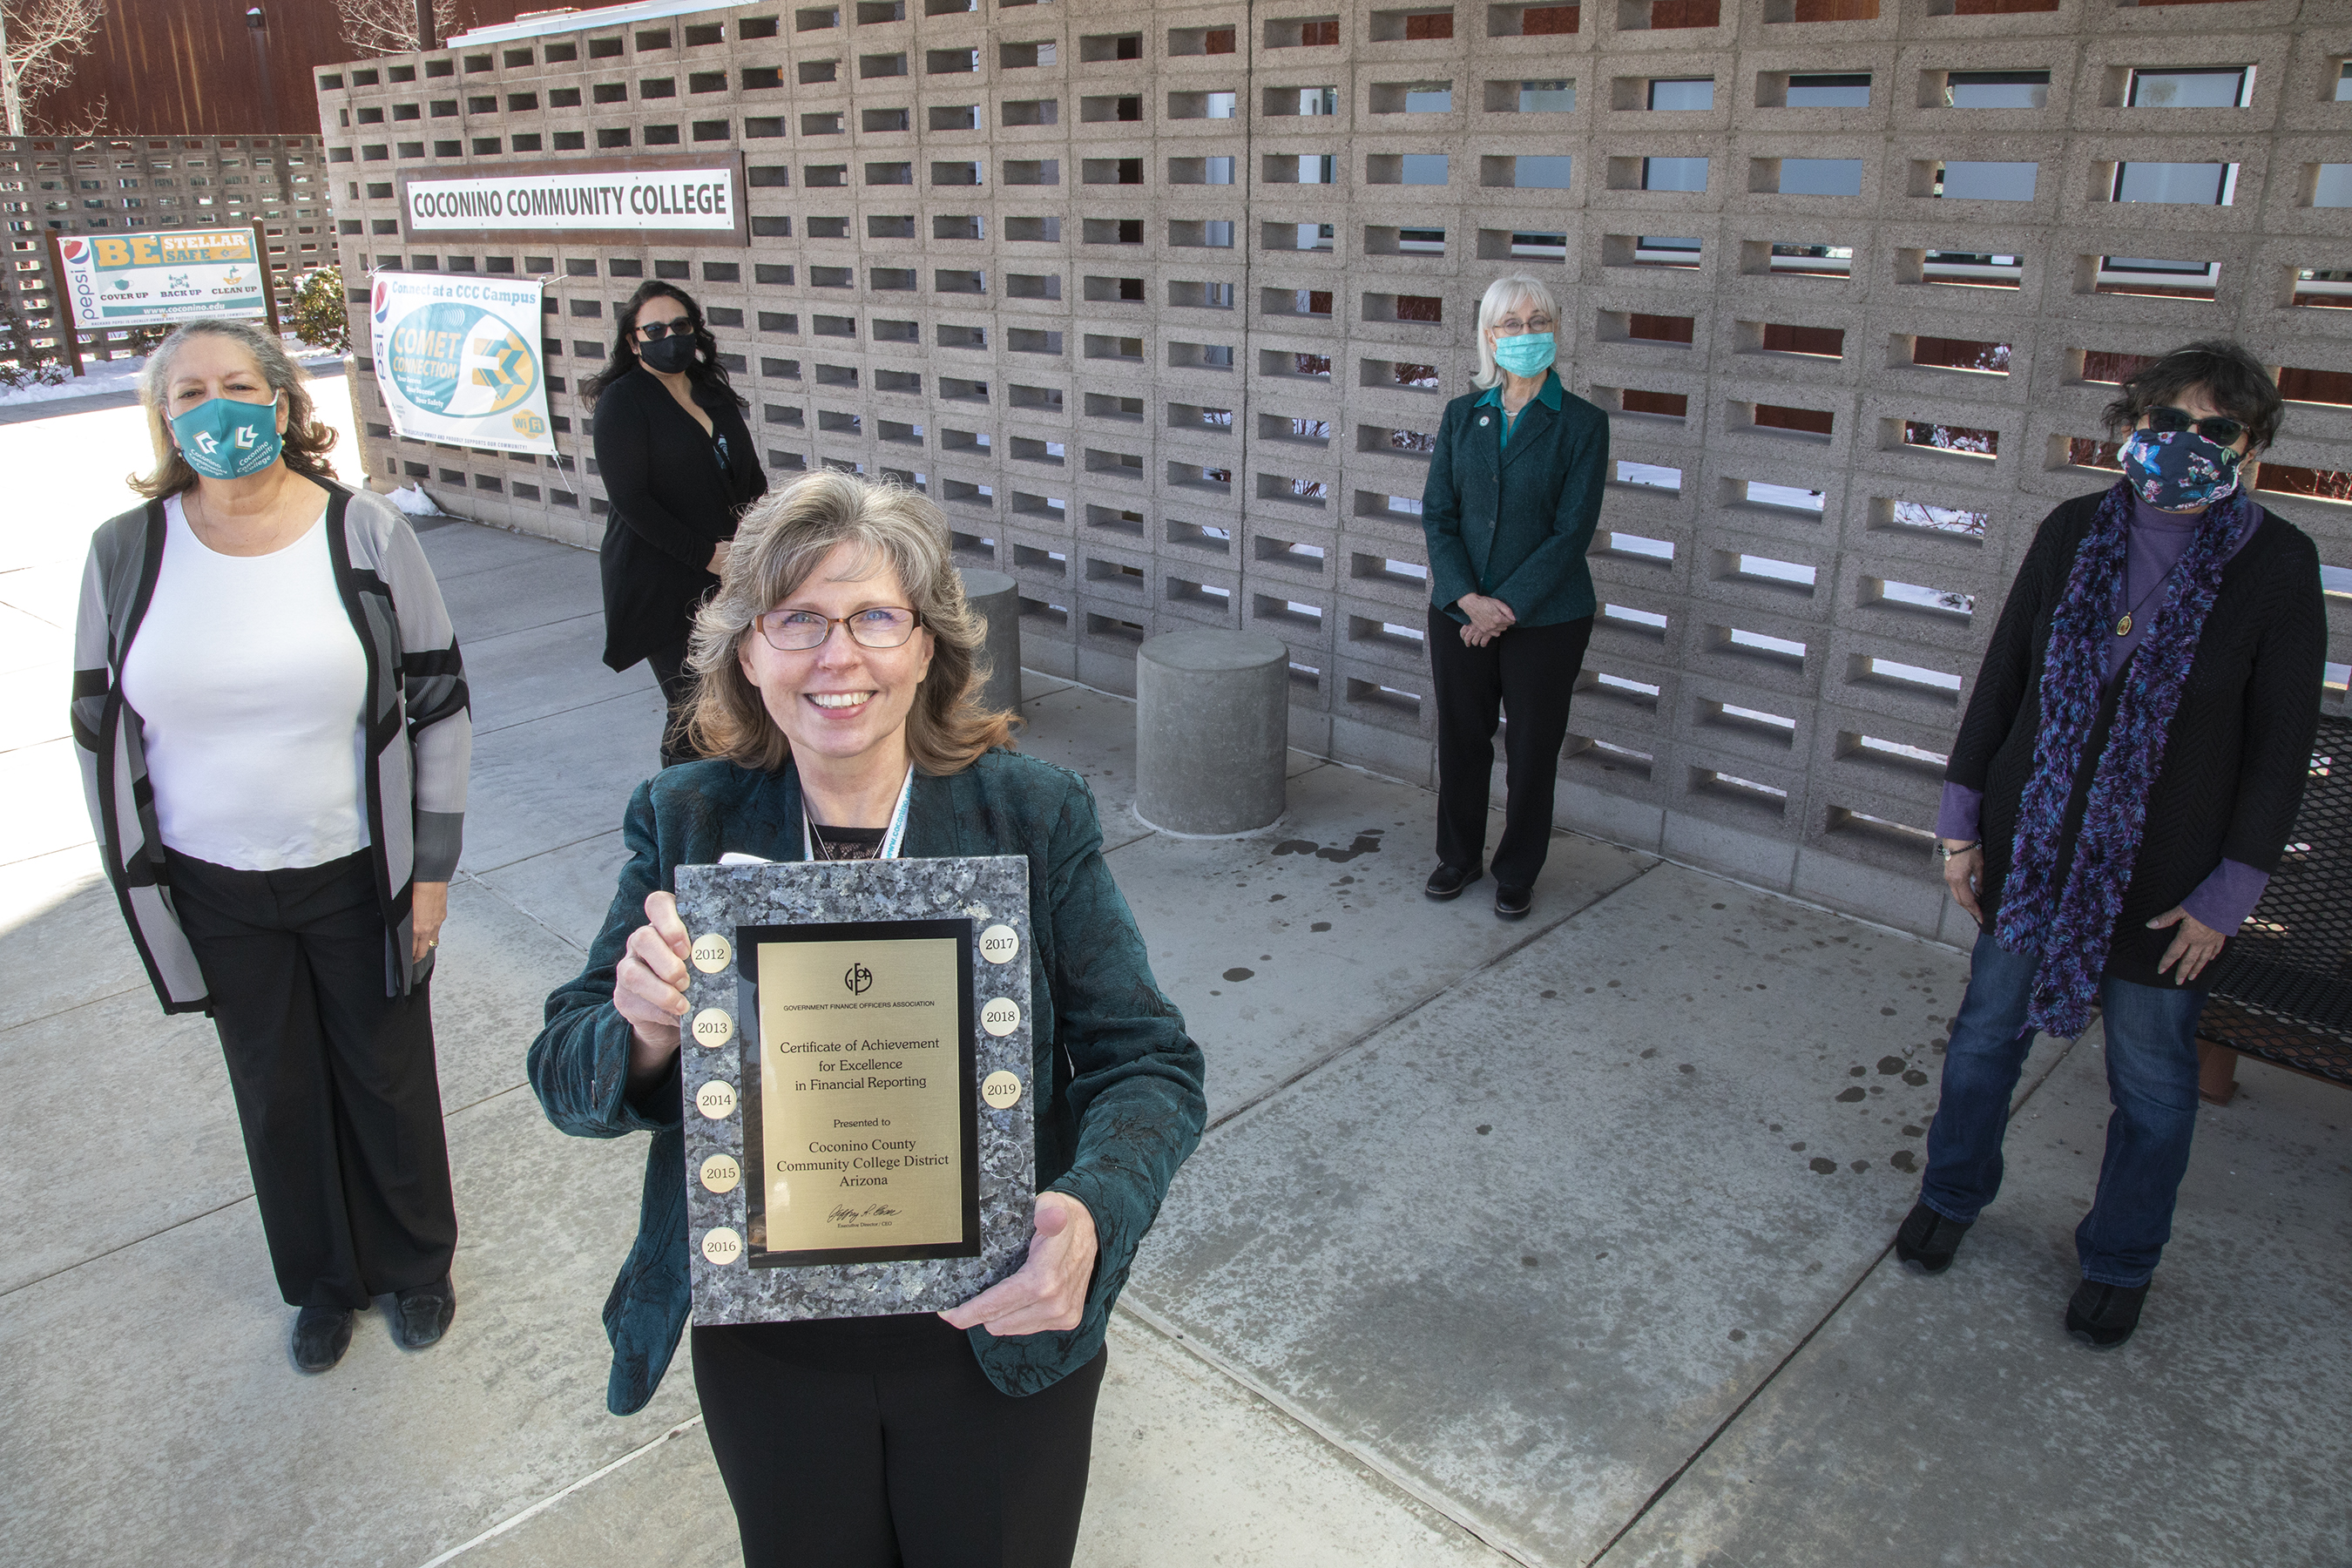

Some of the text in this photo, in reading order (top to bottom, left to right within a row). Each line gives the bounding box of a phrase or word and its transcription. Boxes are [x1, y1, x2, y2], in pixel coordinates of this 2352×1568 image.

[414, 183, 727, 218] COCONINO COMMUNITY COLLEGE
[164, 234, 247, 250] STELLAR
[94, 237, 161, 267] BE
[166, 249, 211, 261] SAFE
[71, 270, 100, 320] pepsi
[392, 280, 536, 307] Connect at a CCC Campus
[143, 302, 225, 314] www.coconino.edu
[394, 327, 462, 359] COMET
[393, 355, 457, 379] CONNECTION
[427, 398, 444, 409] Safety
[191, 449, 221, 469] Coconino
[237, 444, 274, 473] Community
[239, 441, 269, 466] Coconino
[244, 455, 272, 473] College
[985, 937, 1014, 950] 2017
[695, 948, 725, 961] 2012
[986, 1010, 1016, 1024] 2018
[698, 1022, 728, 1034] 2013
[780, 1038, 940, 1053] Certificate of Achievement
[819, 1058, 902, 1071] for Excellence
[795, 1076, 927, 1091] in Financial Reporting
[987, 1083, 1017, 1096] 2019
[702, 1094, 732, 1107] 2014
[834, 1118, 891, 1128] Presented to
[808, 1139, 916, 1153] Coconino County
[776, 1153, 950, 1173] Community College District
[706, 1167, 736, 1179] 2015
[839, 1174, 888, 1187] Arizona
[706, 1240, 736, 1253] 2016
